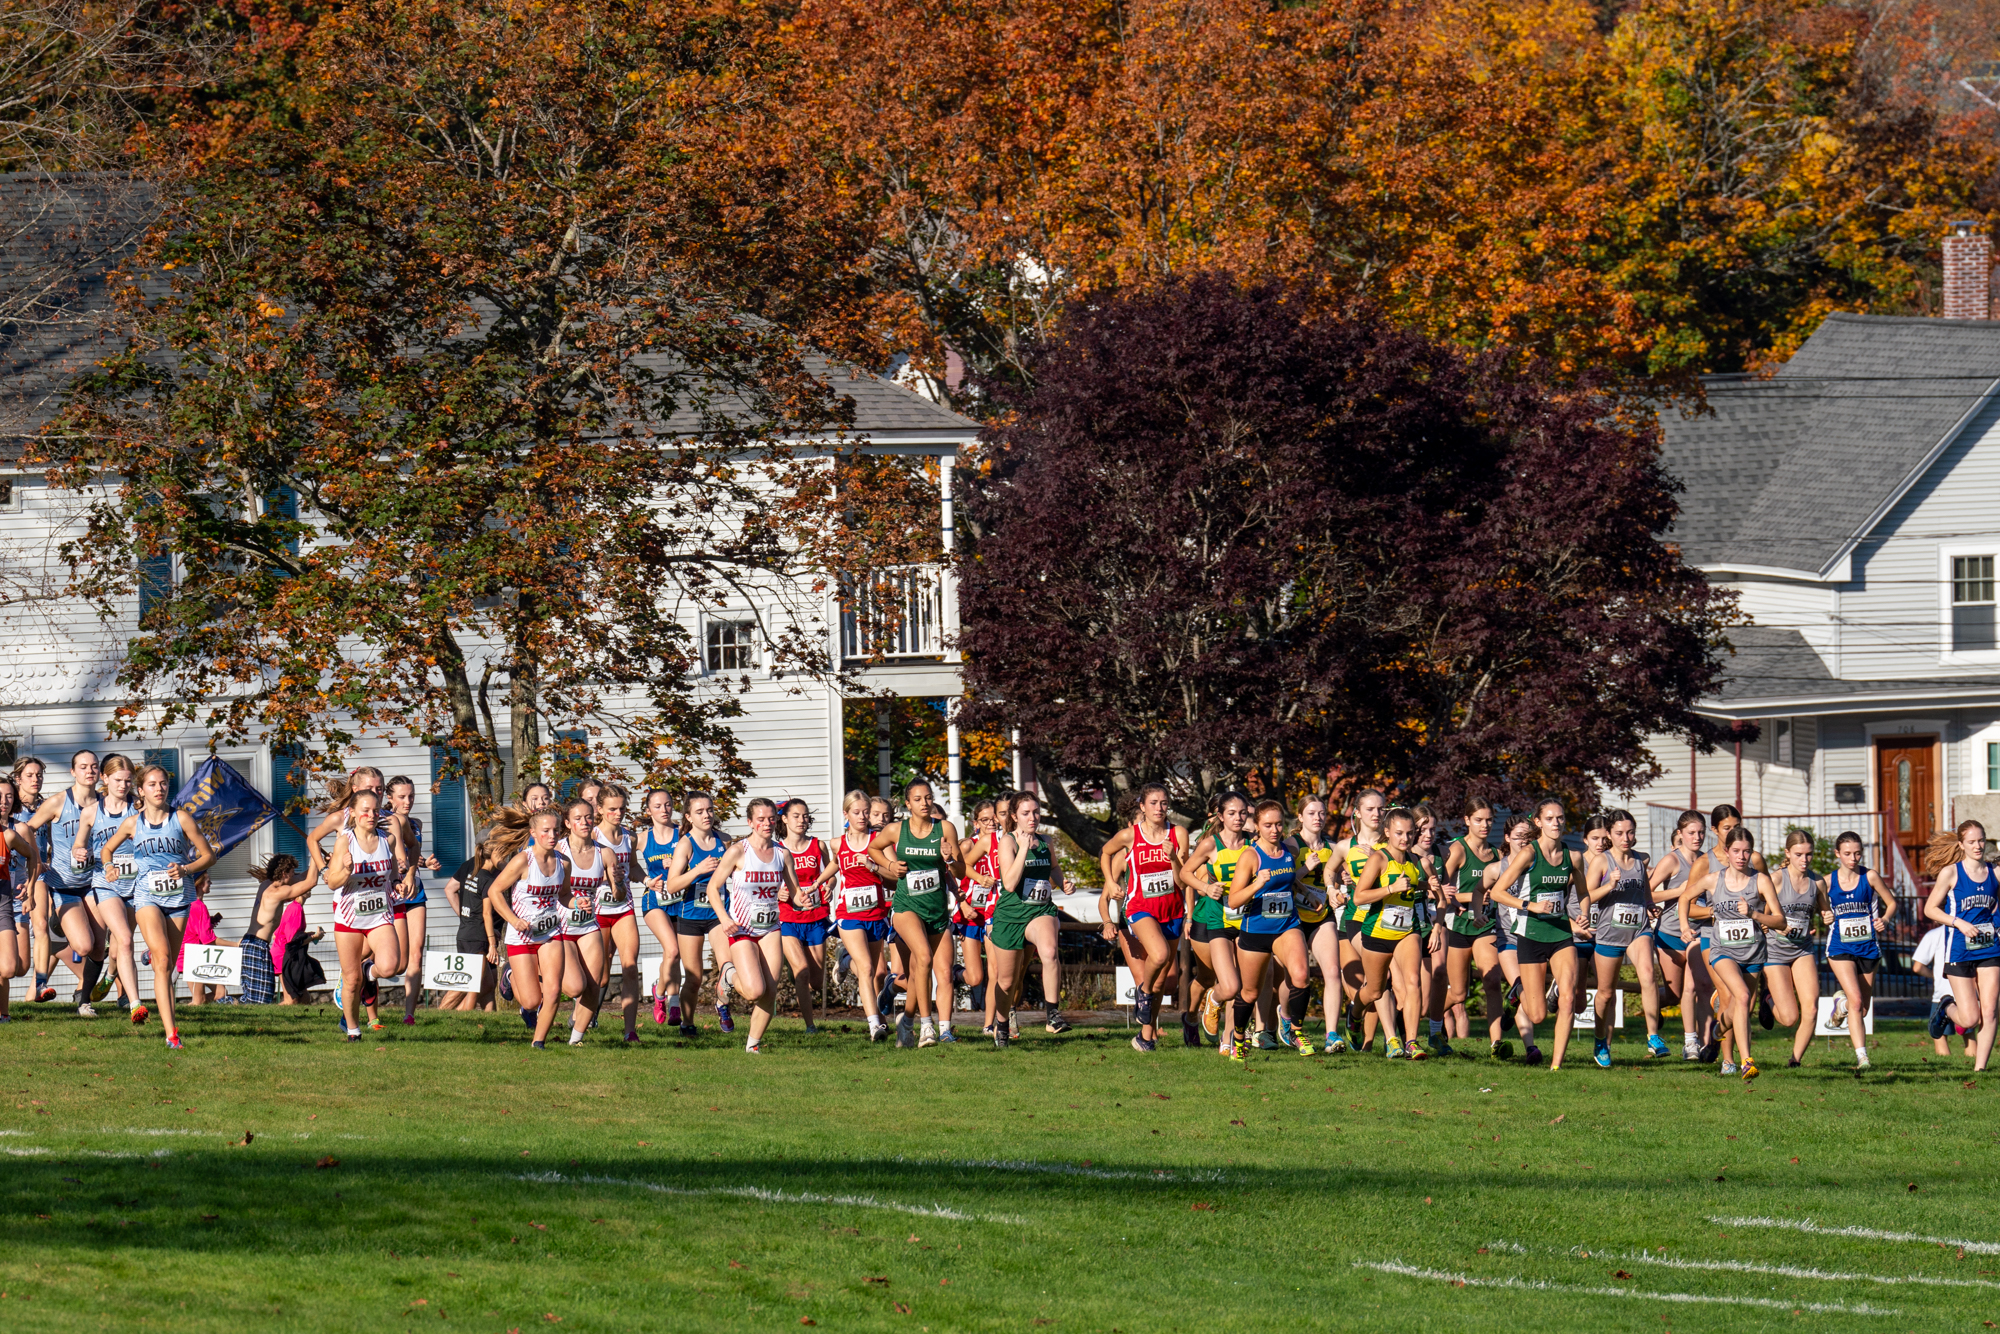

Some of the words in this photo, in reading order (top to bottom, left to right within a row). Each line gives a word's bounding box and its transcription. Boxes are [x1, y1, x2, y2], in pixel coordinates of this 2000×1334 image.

[136, 837, 182, 858] TITANS
[905, 847, 937, 856] CENTRAL
[794, 855, 817, 870] HS
[1025, 858, 1051, 867] CENTRAL
[155, 879, 178, 892] 513
[913, 877, 935, 890] 418
[1147, 879, 1169, 893] 415
[1542, 875, 1568, 884] DOVER
[1028, 888, 1048, 900] 419
[359, 897, 383, 912] 608
[852, 895, 872, 907] 414
[1269, 901, 1288, 914] 817
[538, 914, 558, 931] 607
[757, 911, 777, 924] 612
[1392, 914, 1404, 927] 71
[1618, 913, 1639, 925] 194
[1725, 928, 1749, 941] 192
[1844, 924, 1867, 938] 458
[1970, 931, 1991, 944] 456
[203, 948, 224, 964] 17
[444, 954, 464, 971] 18
